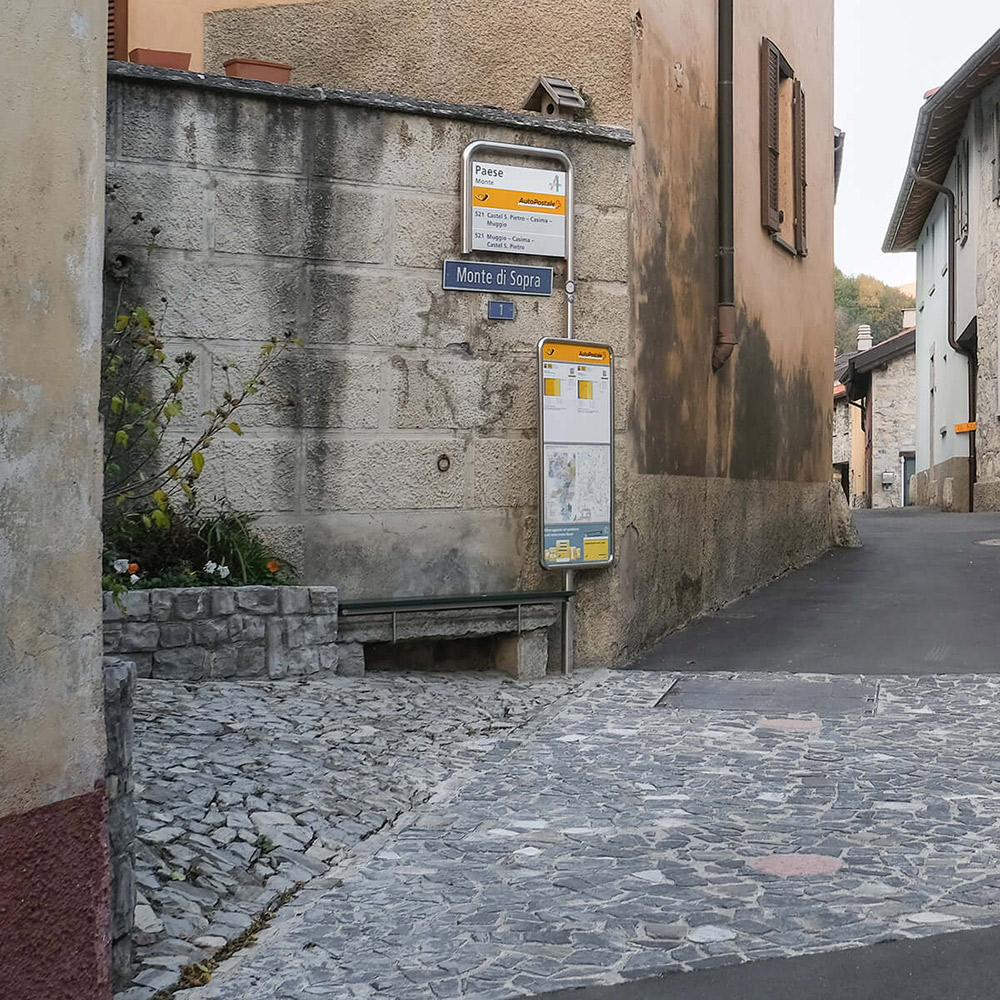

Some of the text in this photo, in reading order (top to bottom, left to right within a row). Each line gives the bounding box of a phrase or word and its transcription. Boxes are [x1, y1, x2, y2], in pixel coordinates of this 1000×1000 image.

[475, 165, 504, 178] Paese
[475, 178, 494, 186] Monte
[518, 197, 556, 208] AutoPostale
[510, 214, 525, 222] Pietro
[487, 241, 503, 249] Castel
[456, 266, 541, 290] Monte di Sopra
[499, 304, 503, 316] 1
